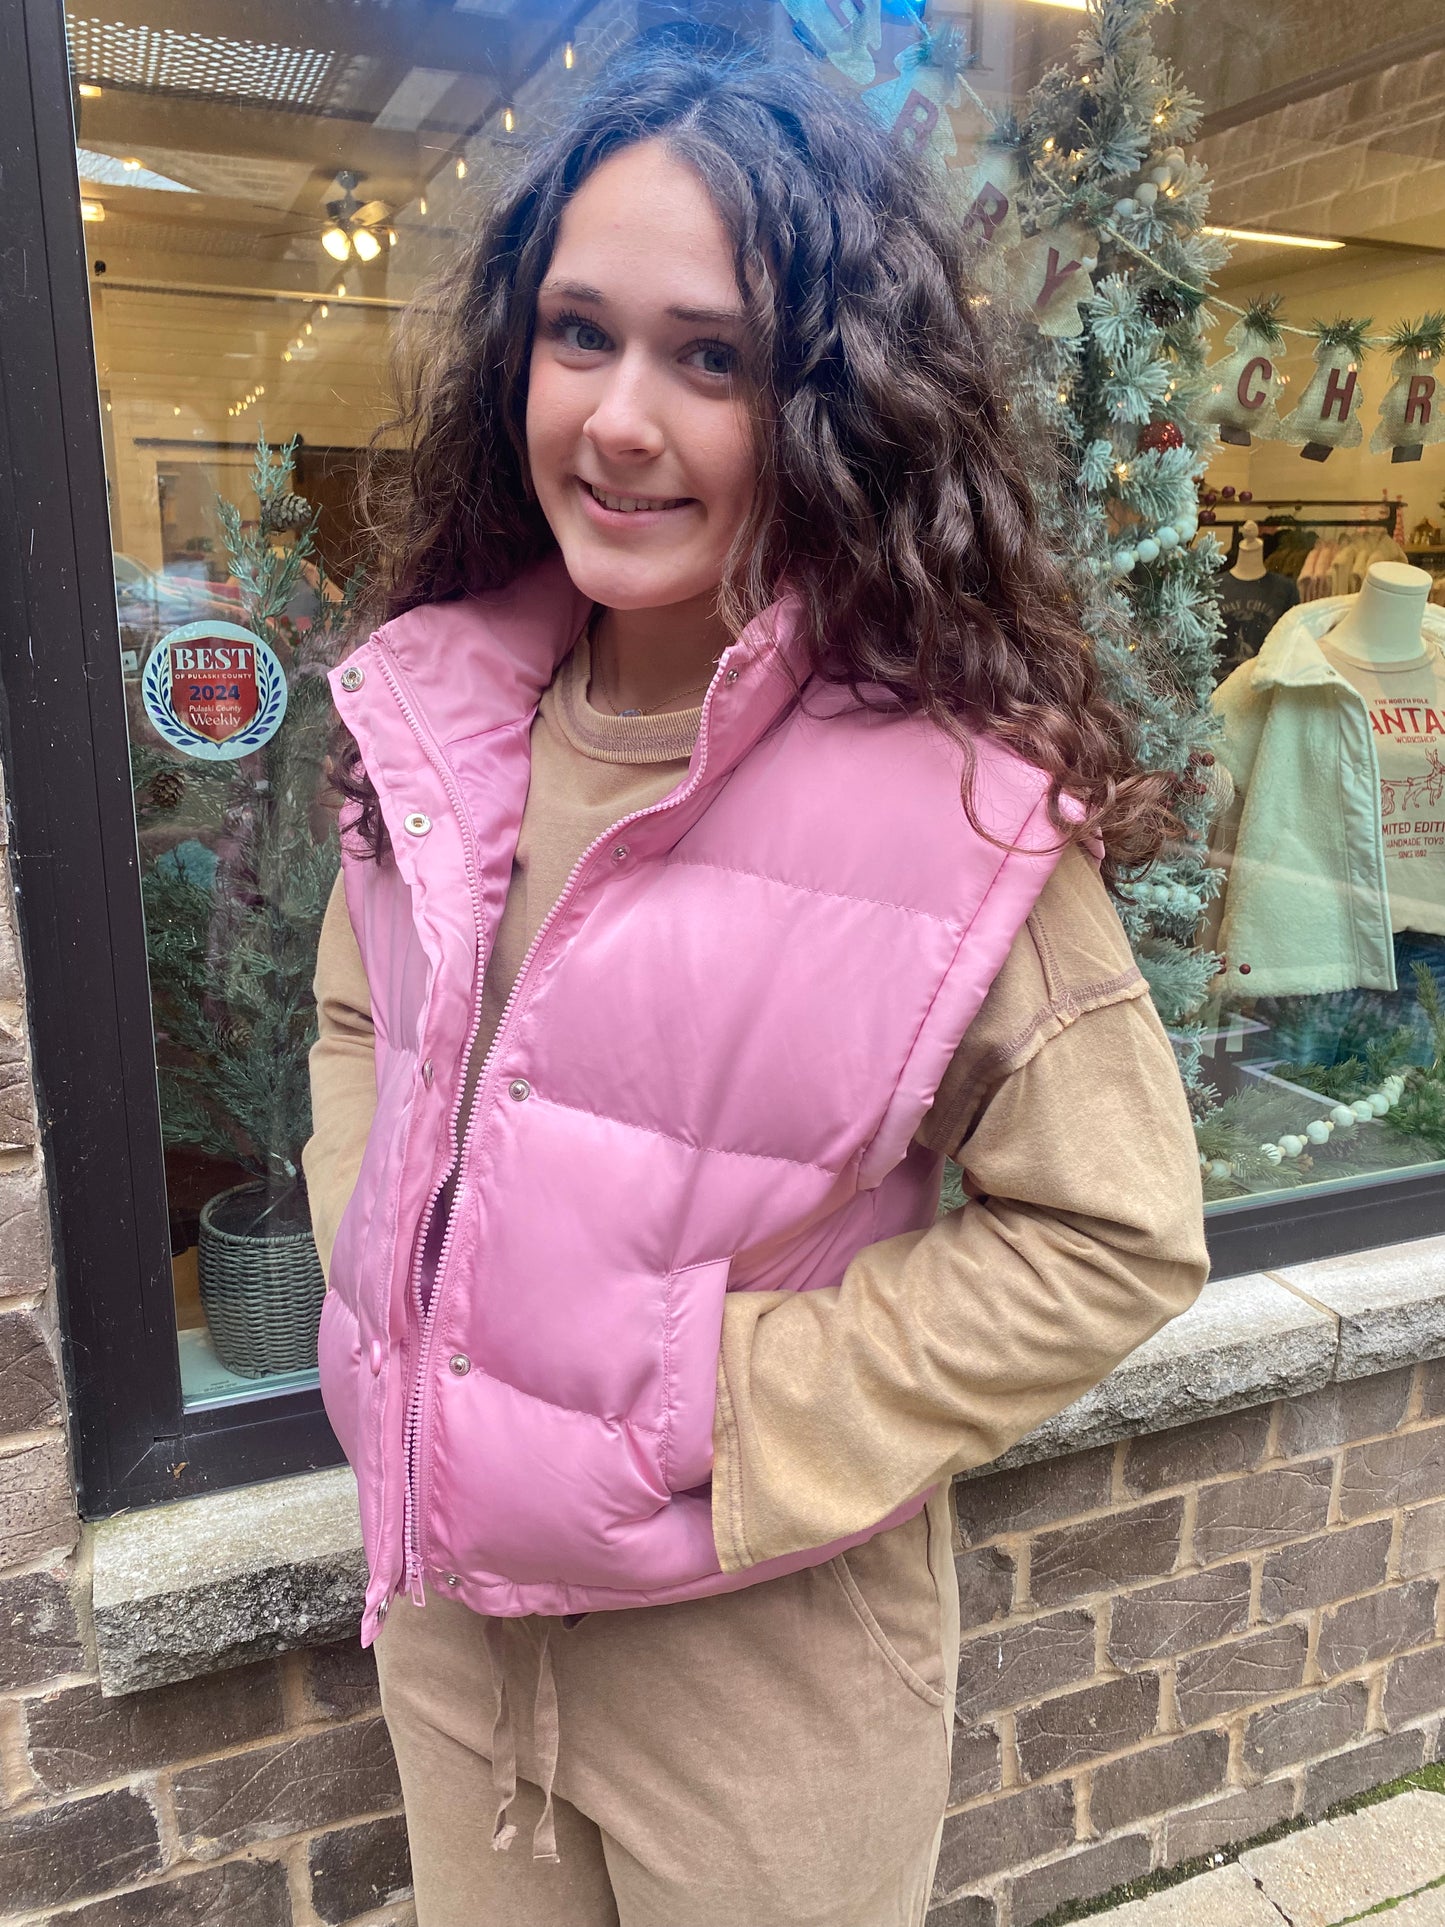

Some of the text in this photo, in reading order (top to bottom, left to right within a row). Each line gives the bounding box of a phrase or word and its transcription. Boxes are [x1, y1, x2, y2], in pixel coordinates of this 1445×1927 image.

[174, 648, 252, 670] BEST
[189, 685, 240, 701] 2024
[189, 704, 241, 713] Pulaski County
[190, 712, 241, 727] Weekly
[1423, 837, 1445, 846] TOYS
[1398, 851, 1413, 859] SINCE
